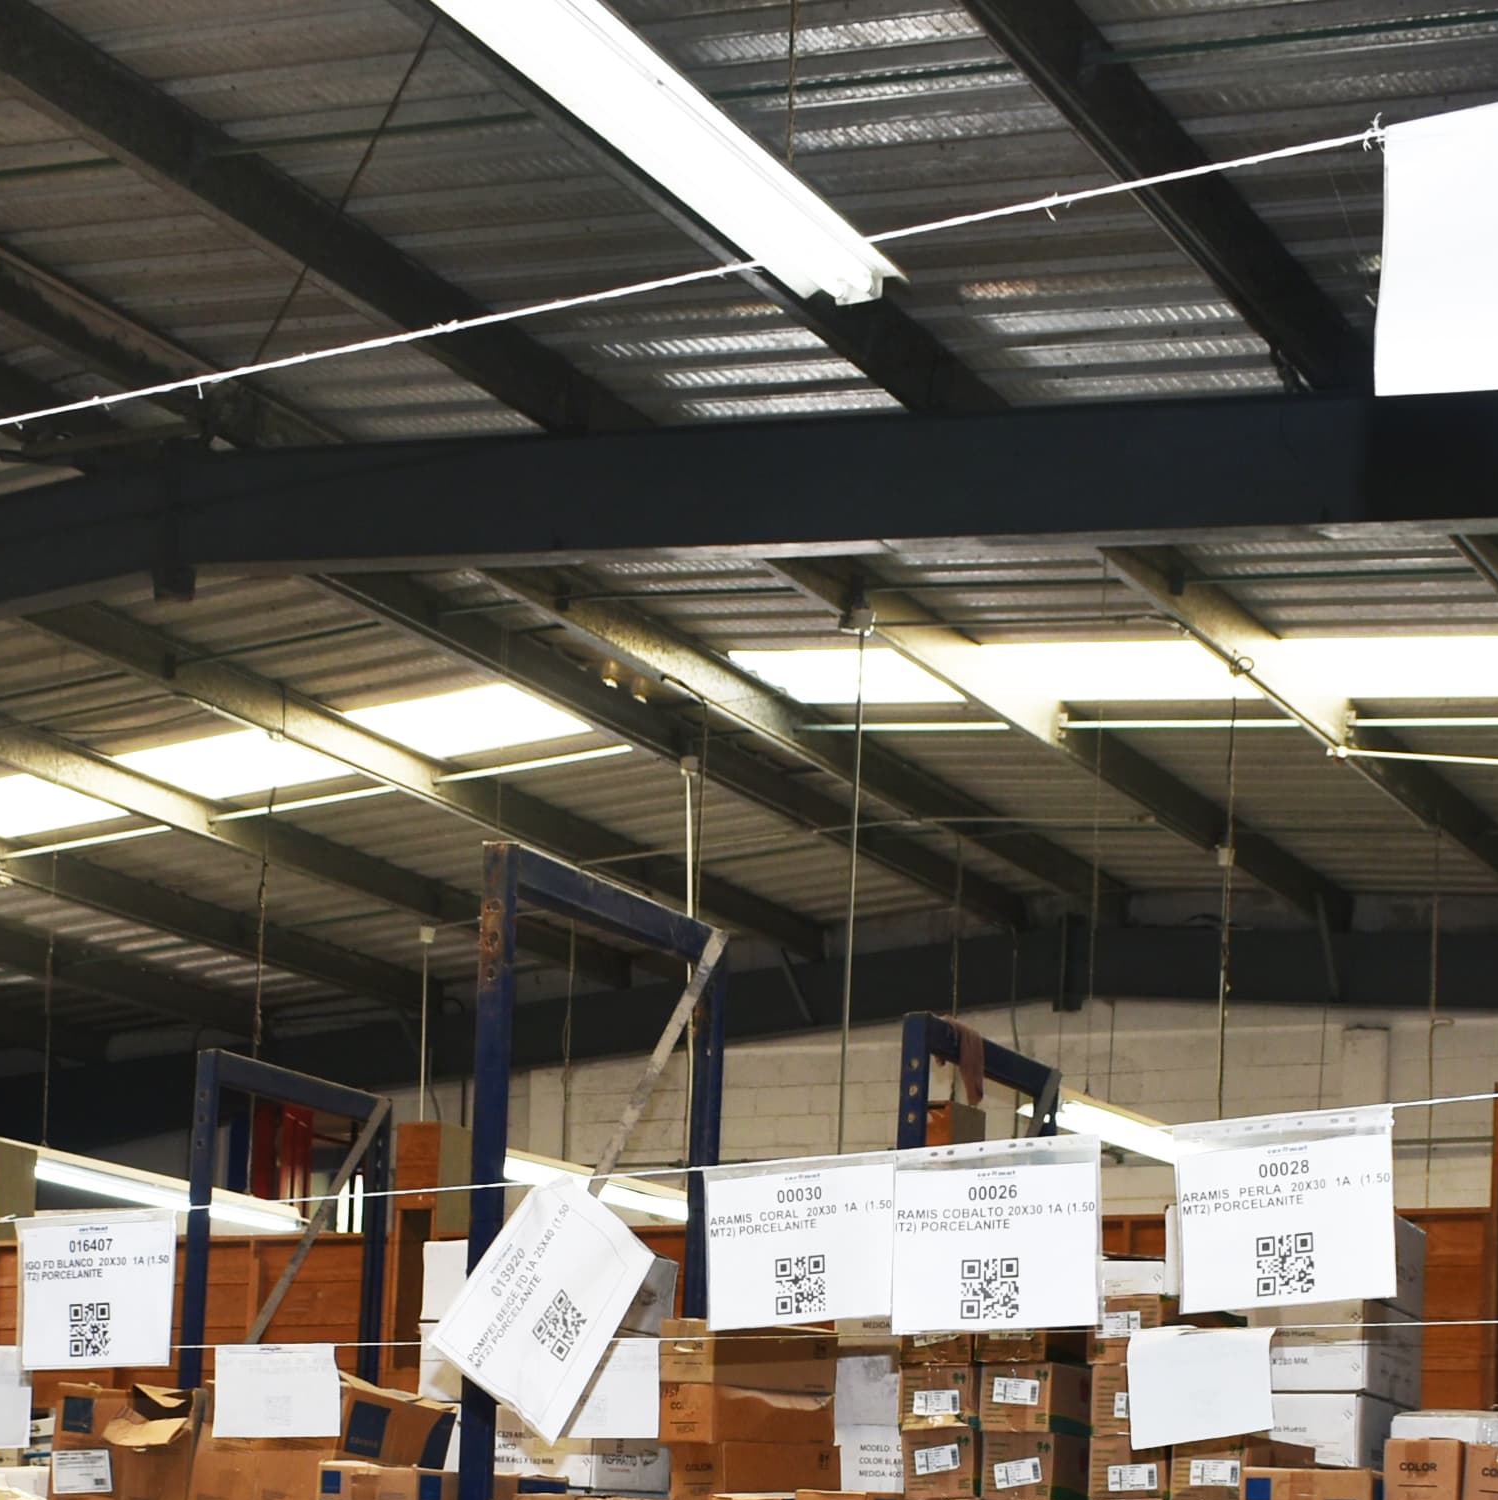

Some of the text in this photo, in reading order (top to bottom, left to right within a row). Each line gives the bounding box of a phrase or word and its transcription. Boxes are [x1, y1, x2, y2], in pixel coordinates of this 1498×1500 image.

[1259, 1160, 1309, 1178] 00028
[777, 1186, 822, 1203] 00030
[968, 1185, 1018, 1200] 00026
[1181, 1172, 1391, 1203] ARAMIS PERLA 20X30 1A (1.50
[710, 1200, 892, 1226] ARAMIS CORAL 20X30 1A (1.50
[897, 1202, 1095, 1220] RAMIS COBALTO 20X30 1A (1.50
[1182, 1195, 1304, 1216] MT2) PORCELANITE
[710, 1219, 817, 1238] MT2) PORCELANITE
[921, 1219, 1010, 1232] PORCELANITE
[69, 1239, 113, 1253] 016407
[43, 1255, 169, 1268] FD BLANCO 20X30 1A (1.50
[42, 1269, 103, 1280] PORCELANITE
[491, 1248, 526, 1298] 013920
[467, 1203, 570, 1364] POMPEI BEIGE FD 1A 25X40 (1.50
[474, 1275, 542, 1370] MT2) PORCELANITE
[1399, 1462, 1437, 1473] COLOR
